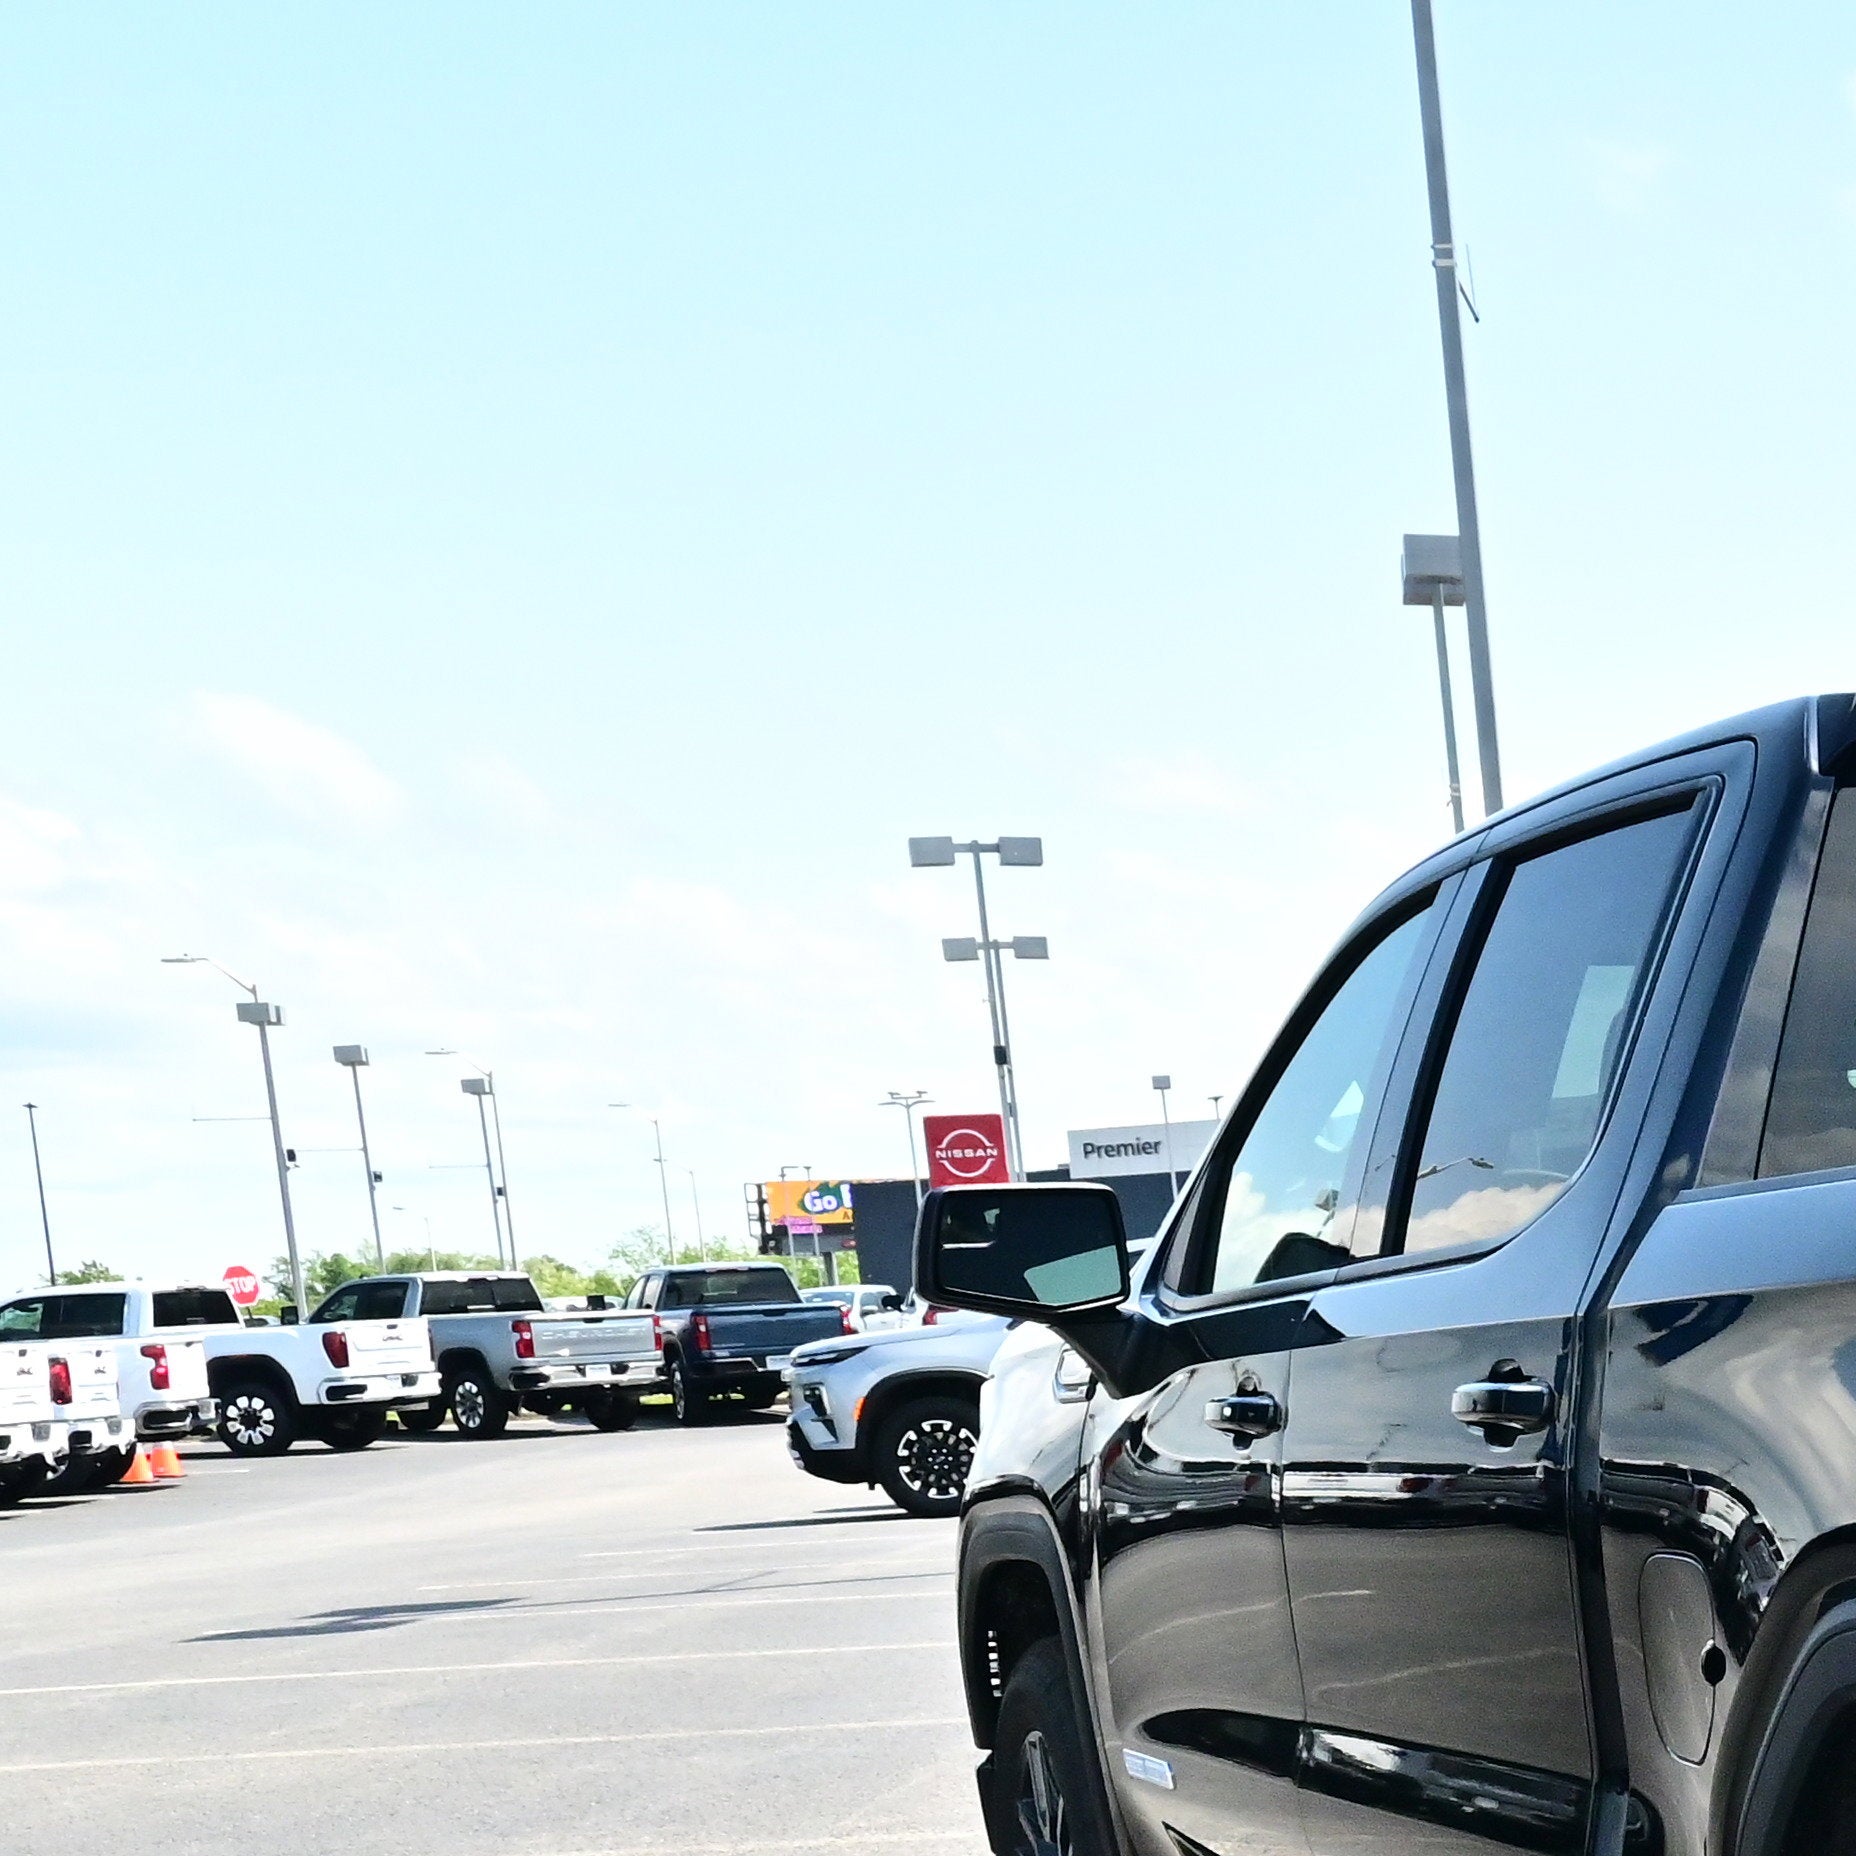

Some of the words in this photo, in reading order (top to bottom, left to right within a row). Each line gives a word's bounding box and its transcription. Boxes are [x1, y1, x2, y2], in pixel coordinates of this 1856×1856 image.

[935, 1147, 998, 1159] NISSAN
[1082, 1137, 1162, 1160] Premier
[803, 1190, 838, 1213] Go
